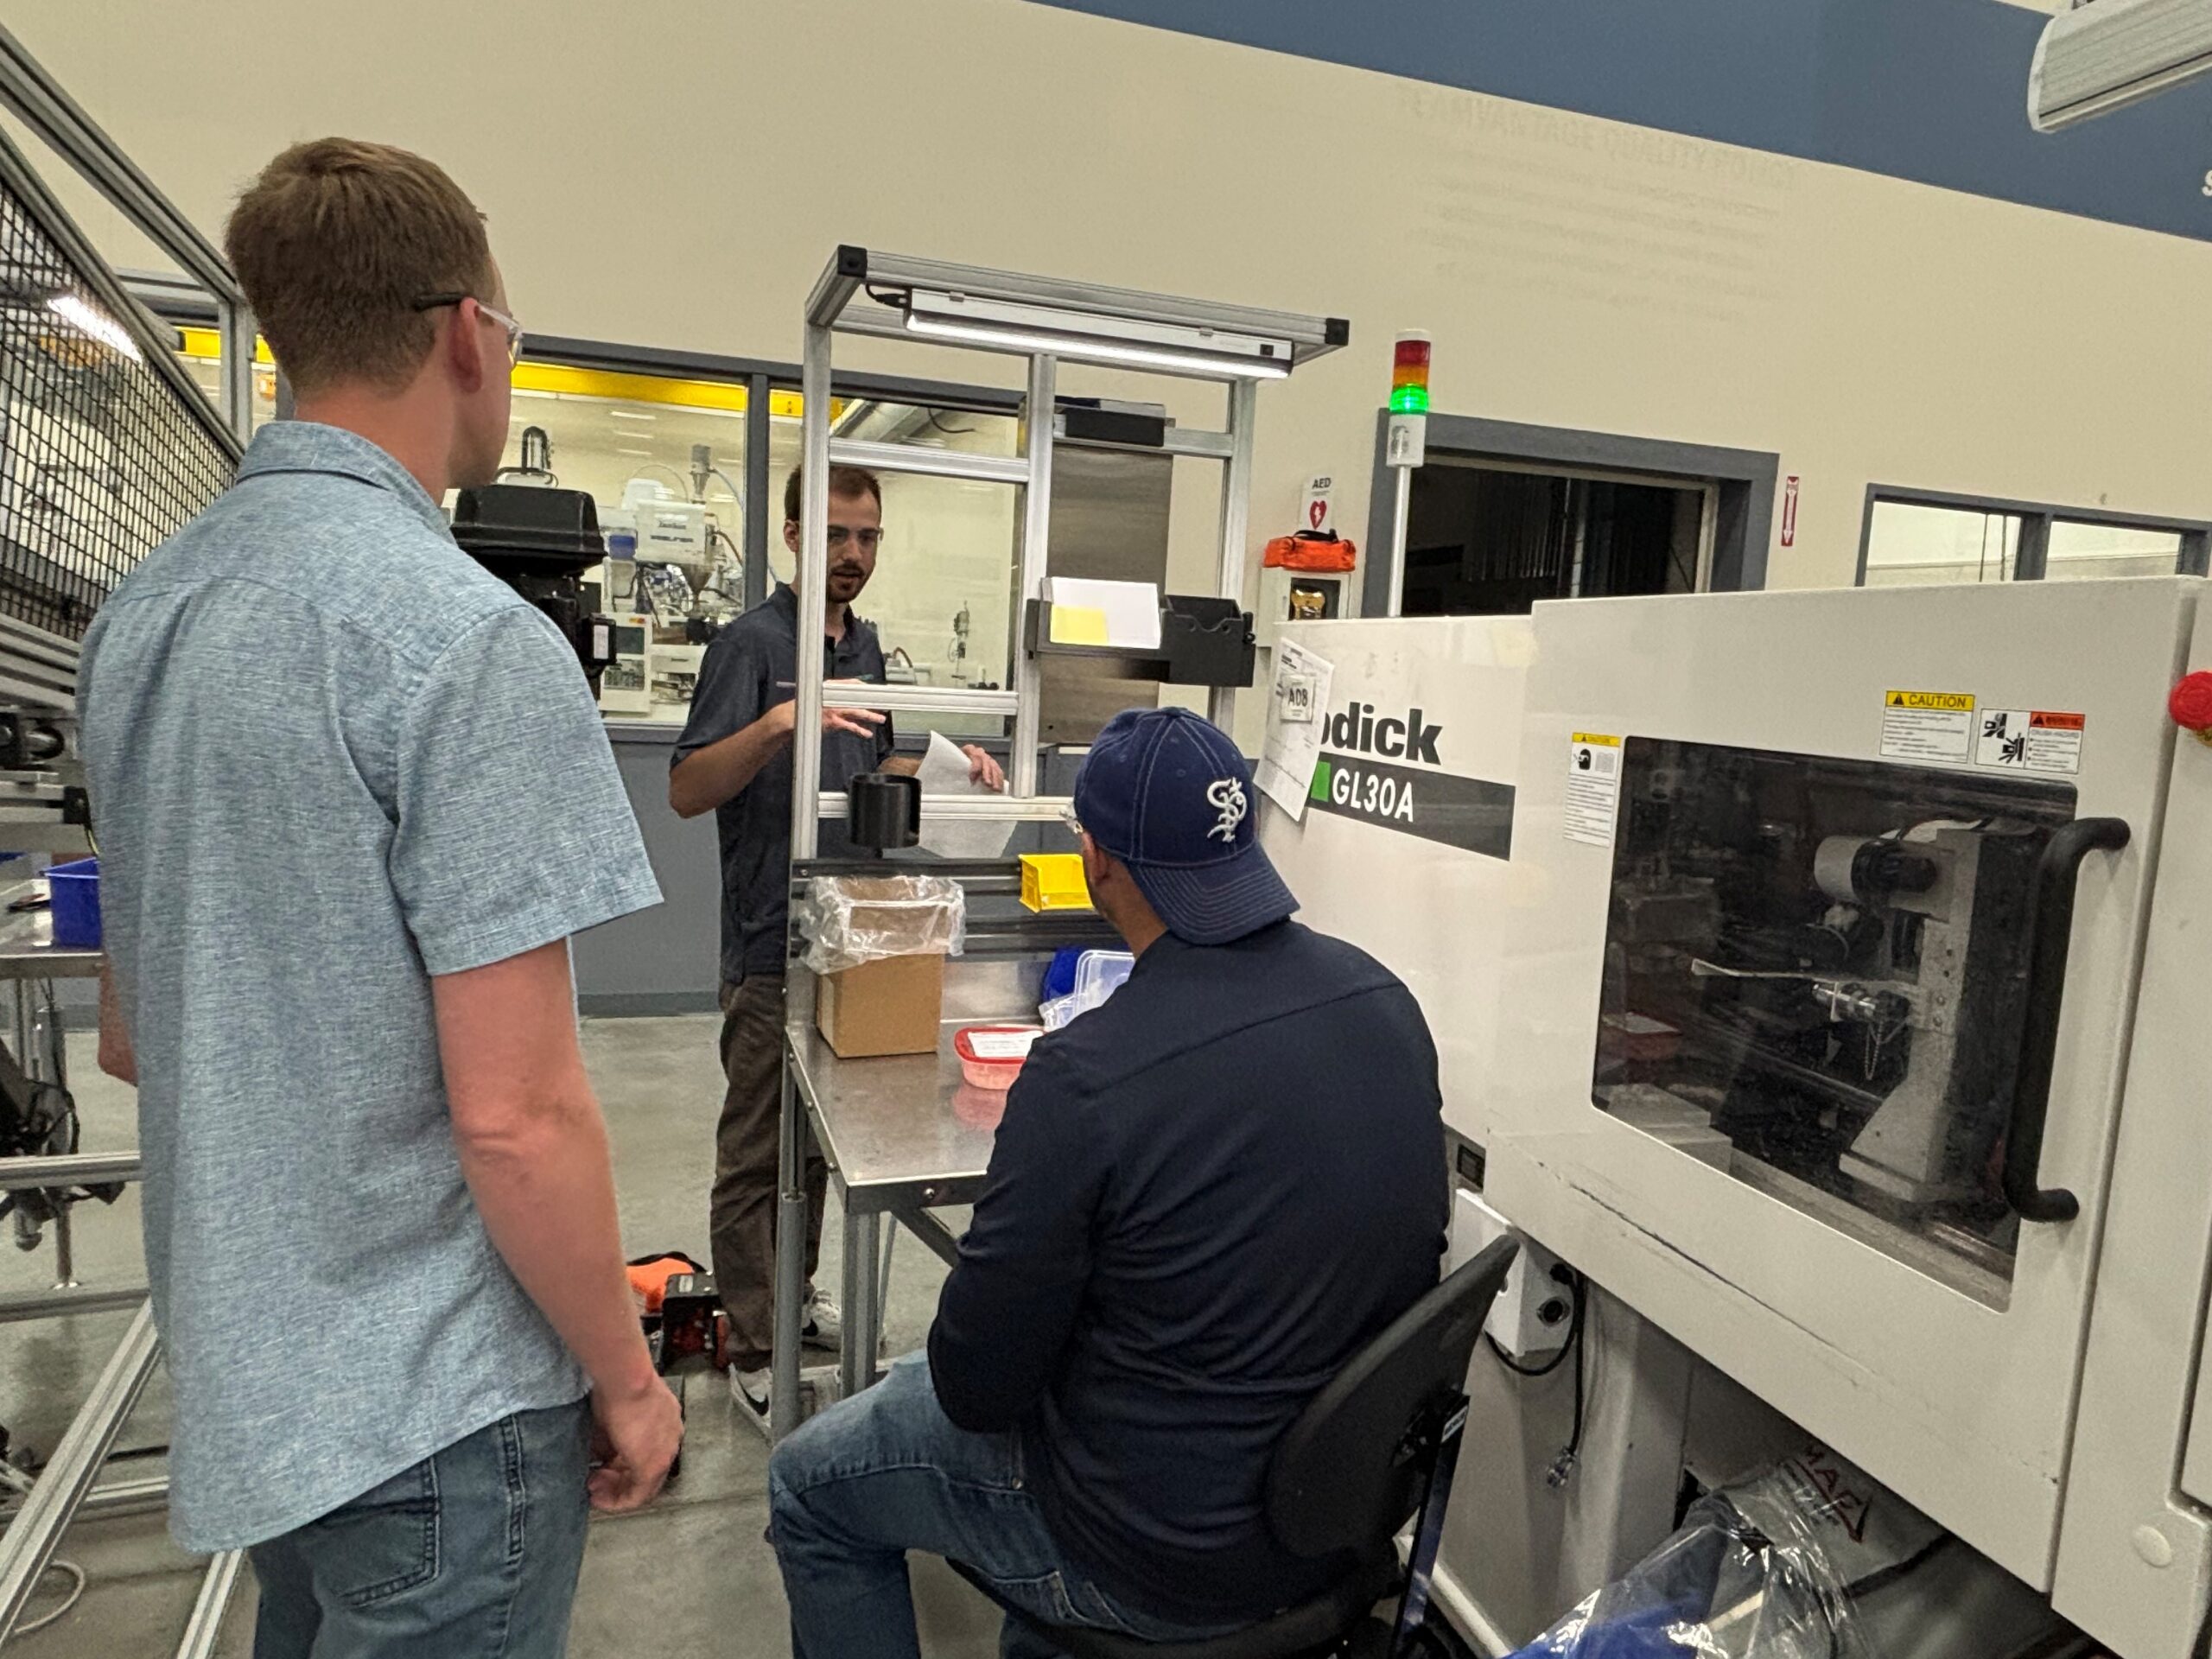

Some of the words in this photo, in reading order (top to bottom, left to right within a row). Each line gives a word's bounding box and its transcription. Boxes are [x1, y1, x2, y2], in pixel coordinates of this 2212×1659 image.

[1312, 477, 1332, 489] AED
[1909, 694, 1967, 708] CAUTION
[1332, 767, 1414, 823] GL30A
